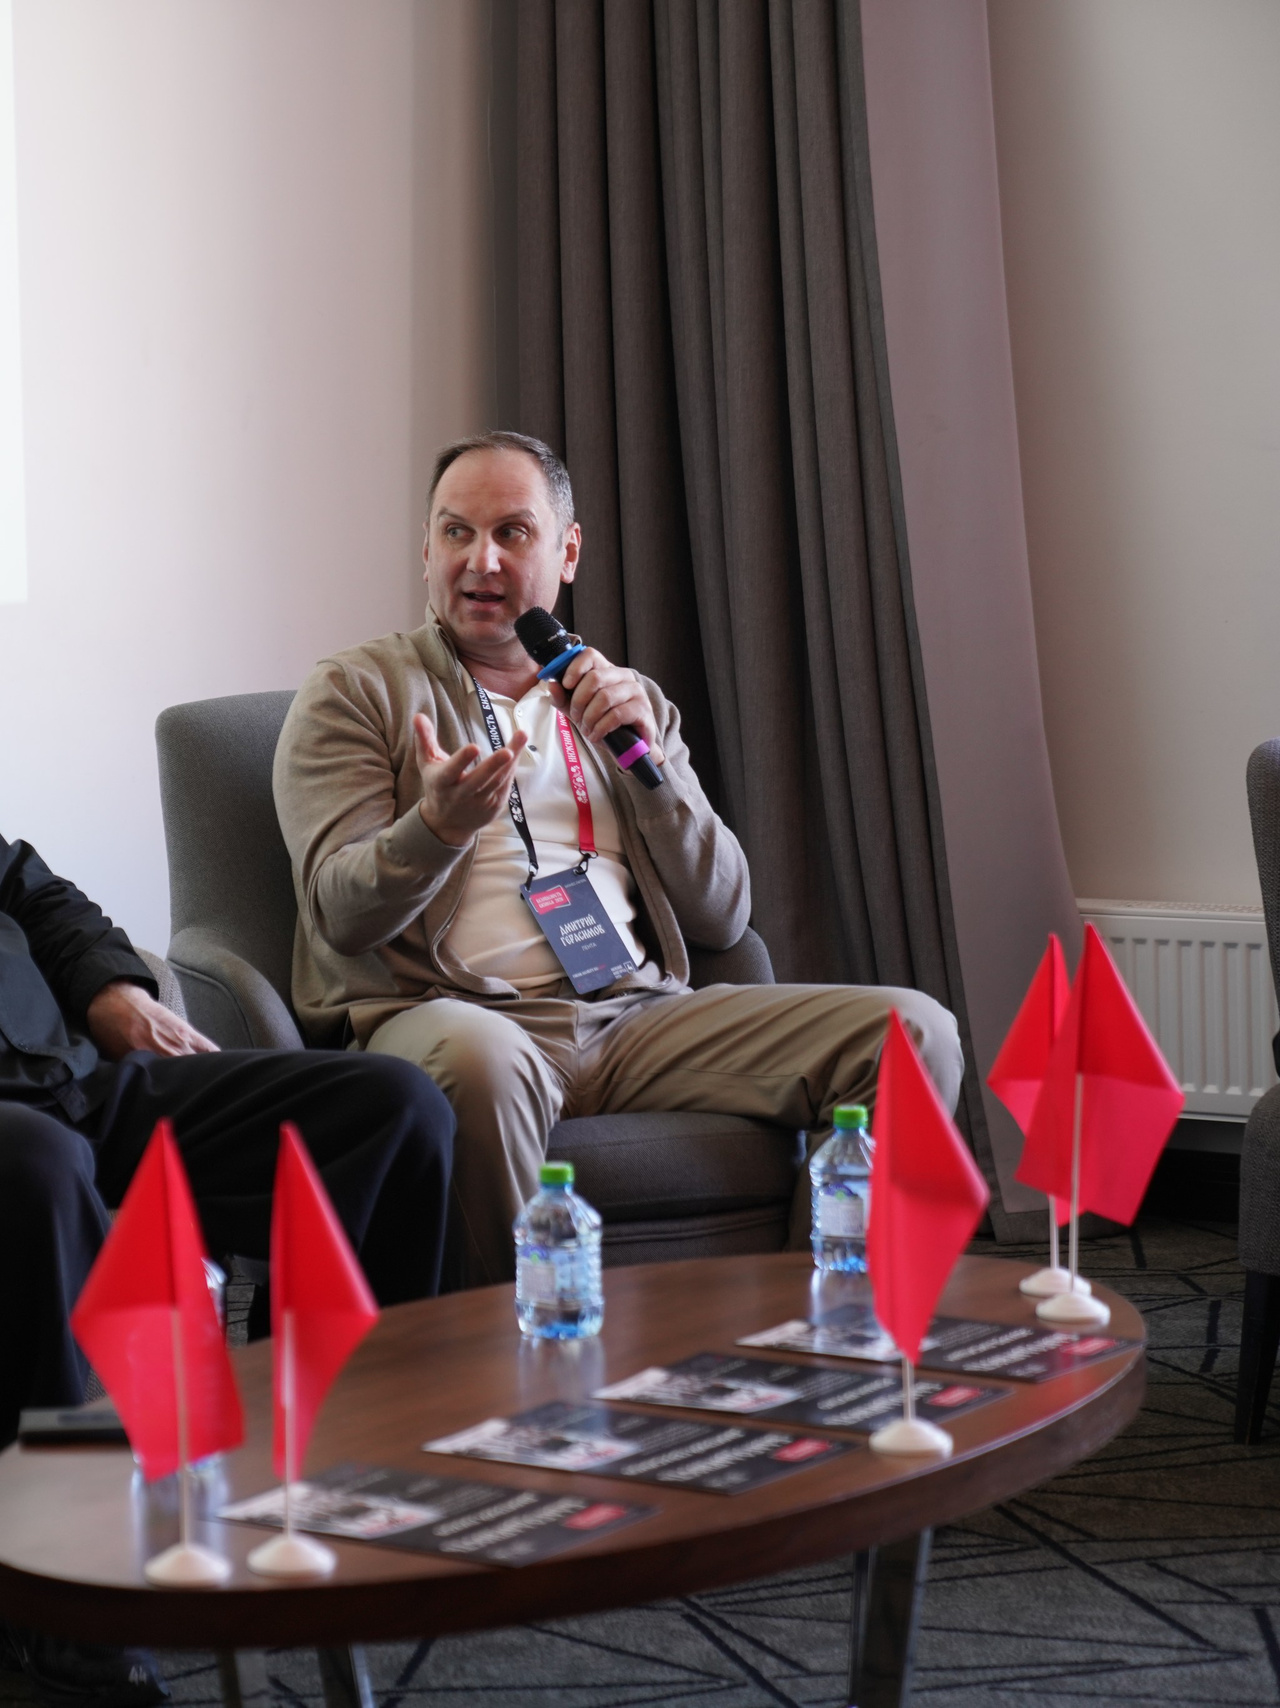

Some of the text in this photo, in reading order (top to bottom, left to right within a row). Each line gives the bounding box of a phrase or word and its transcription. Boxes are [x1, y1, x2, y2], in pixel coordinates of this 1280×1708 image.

[485, 714, 502, 751] АСНОСТЬ
[557, 709, 577, 763] НИЖНИЙ НОВ
[559, 913, 596, 936] ДМИТРИЙ
[560, 923, 605, 947] ГЕРАСИМОВ
